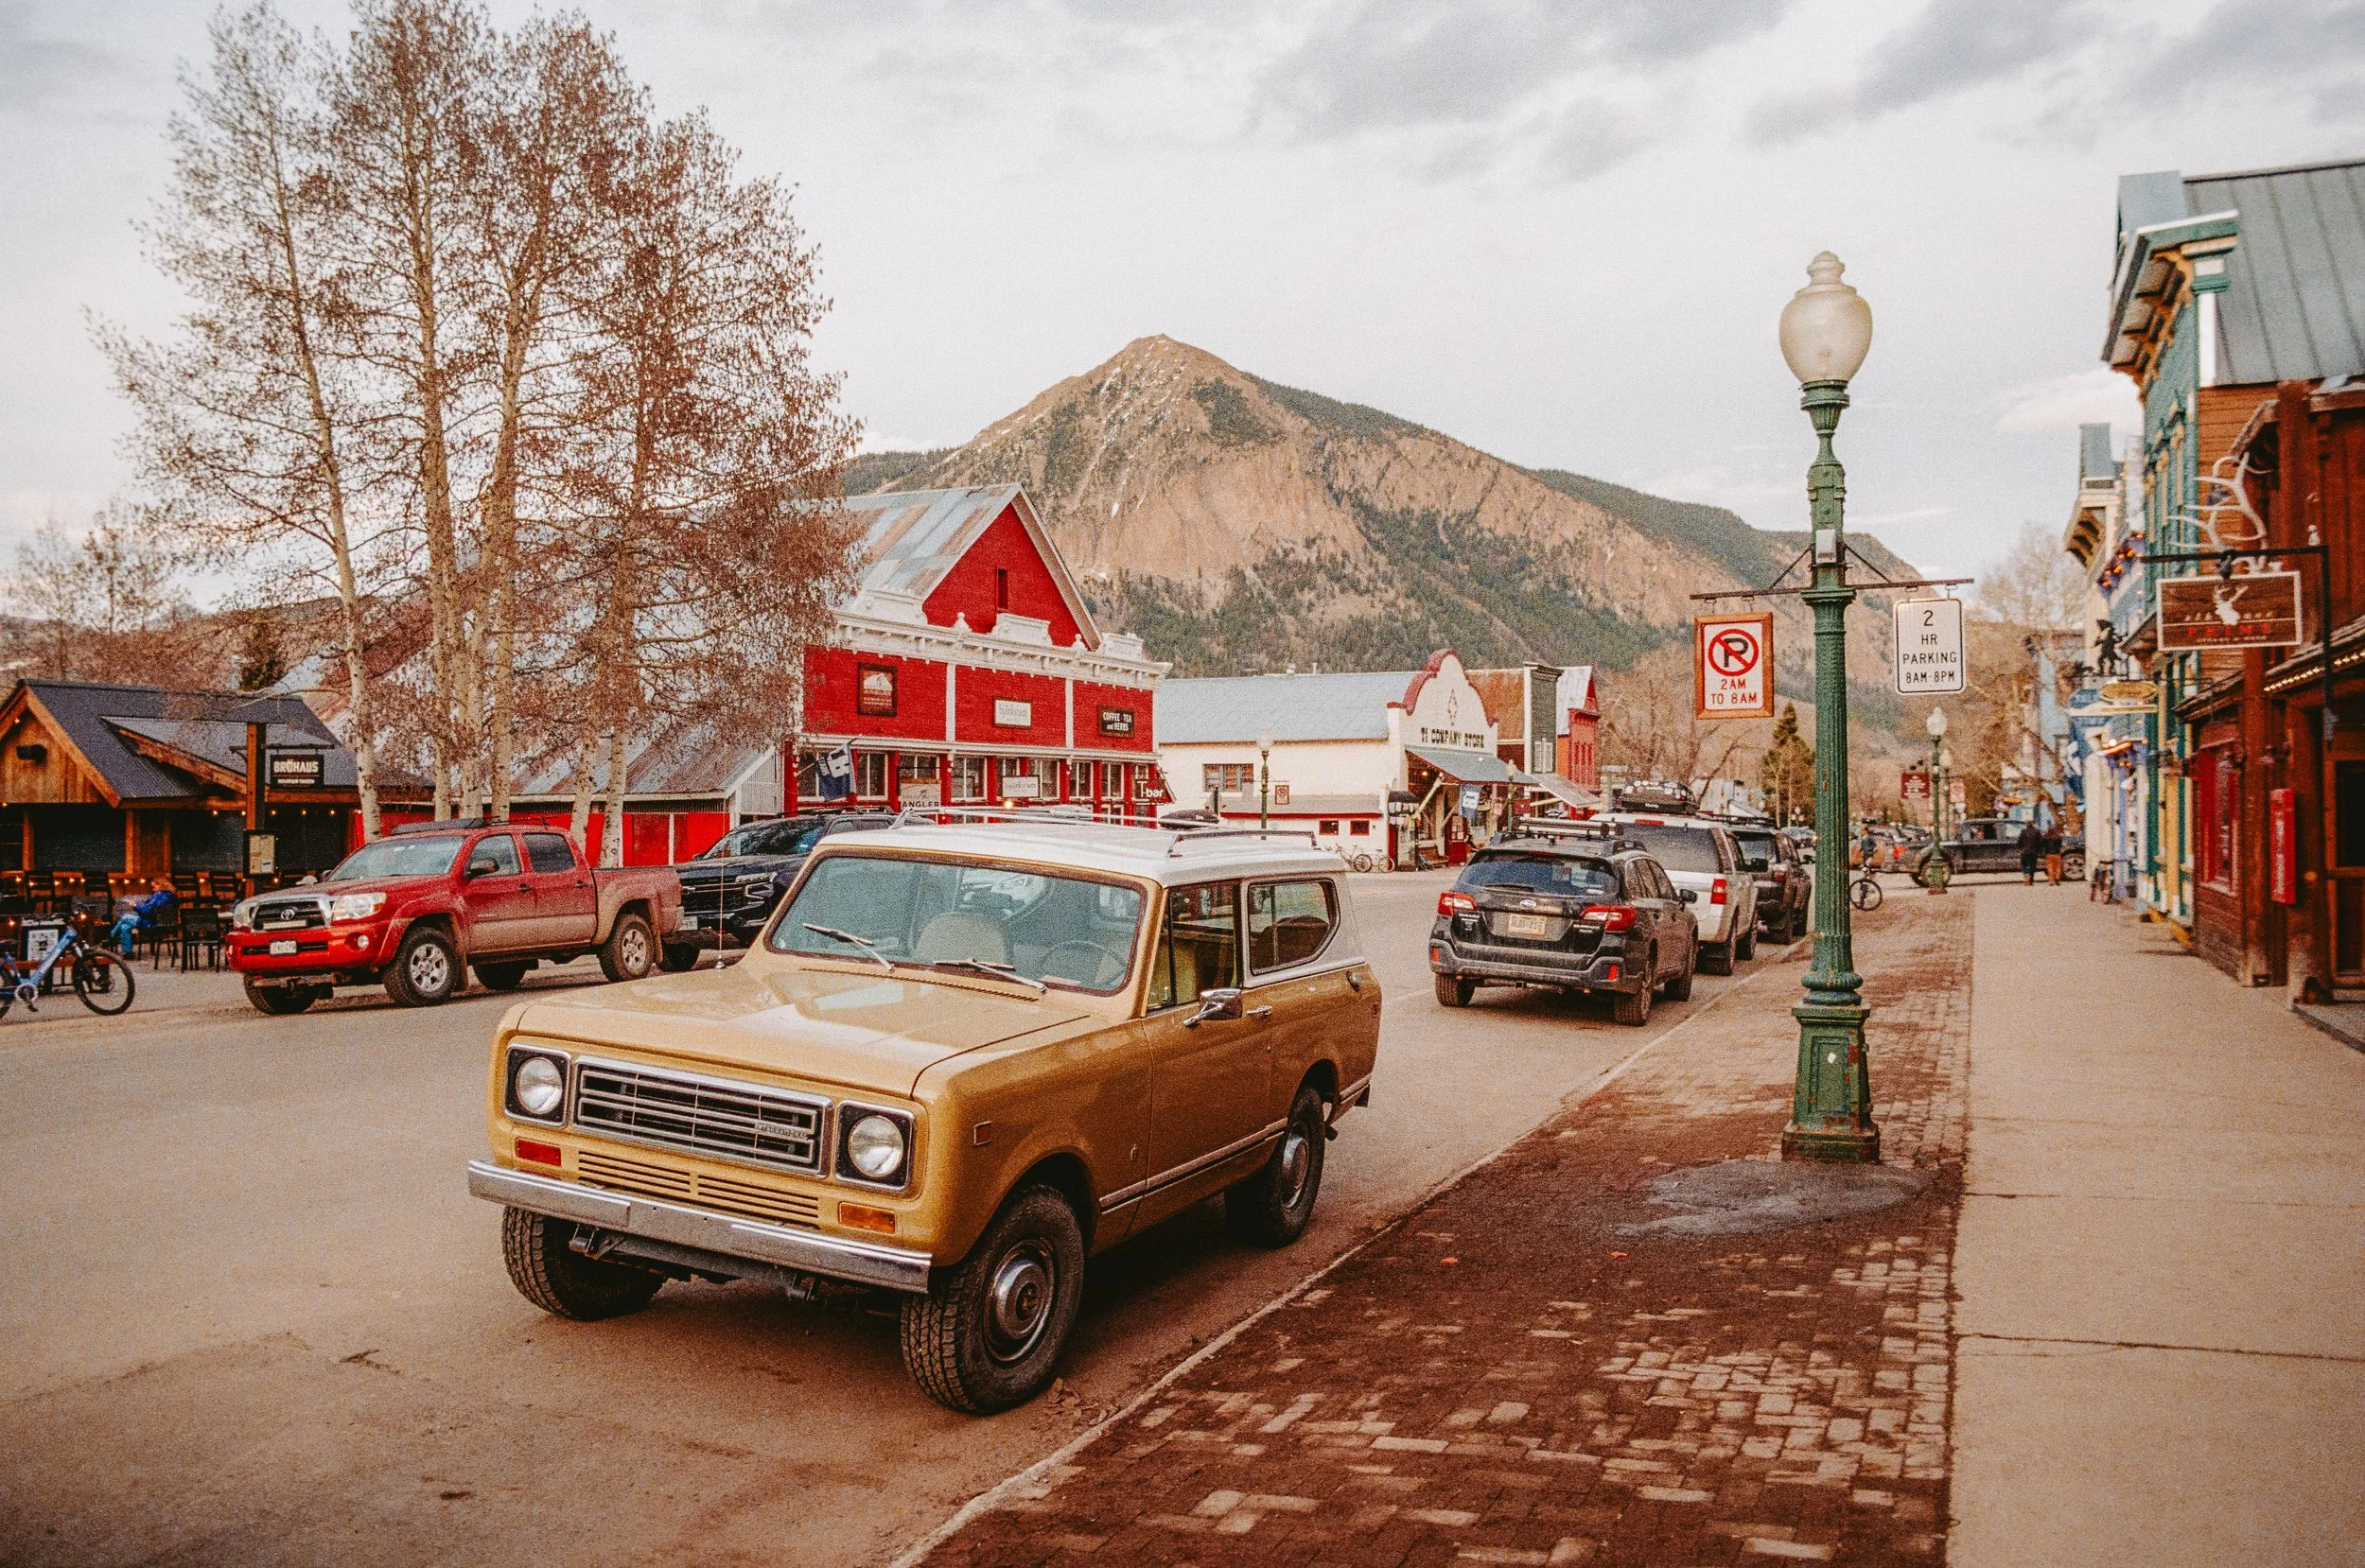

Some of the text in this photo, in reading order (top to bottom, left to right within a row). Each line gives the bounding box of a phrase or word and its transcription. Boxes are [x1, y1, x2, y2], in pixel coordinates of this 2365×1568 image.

[1922, 609, 1935, 627] 2
[2187, 622, 2271, 637] PRIME
[1920, 633, 1938, 646] HR
[1902, 652, 1958, 665] PARKING
[1721, 678, 1747, 690] 2AM
[1710, 691, 1758, 705] TO 8AM
[1102, 711, 1133, 723] COFFEE TEA
[1114, 722, 1130, 732] HERBS
[1431, 728, 1462, 746] COMPANY
[1464, 732, 1485, 749] STORE
[1136, 780, 1165, 798] T-bar
